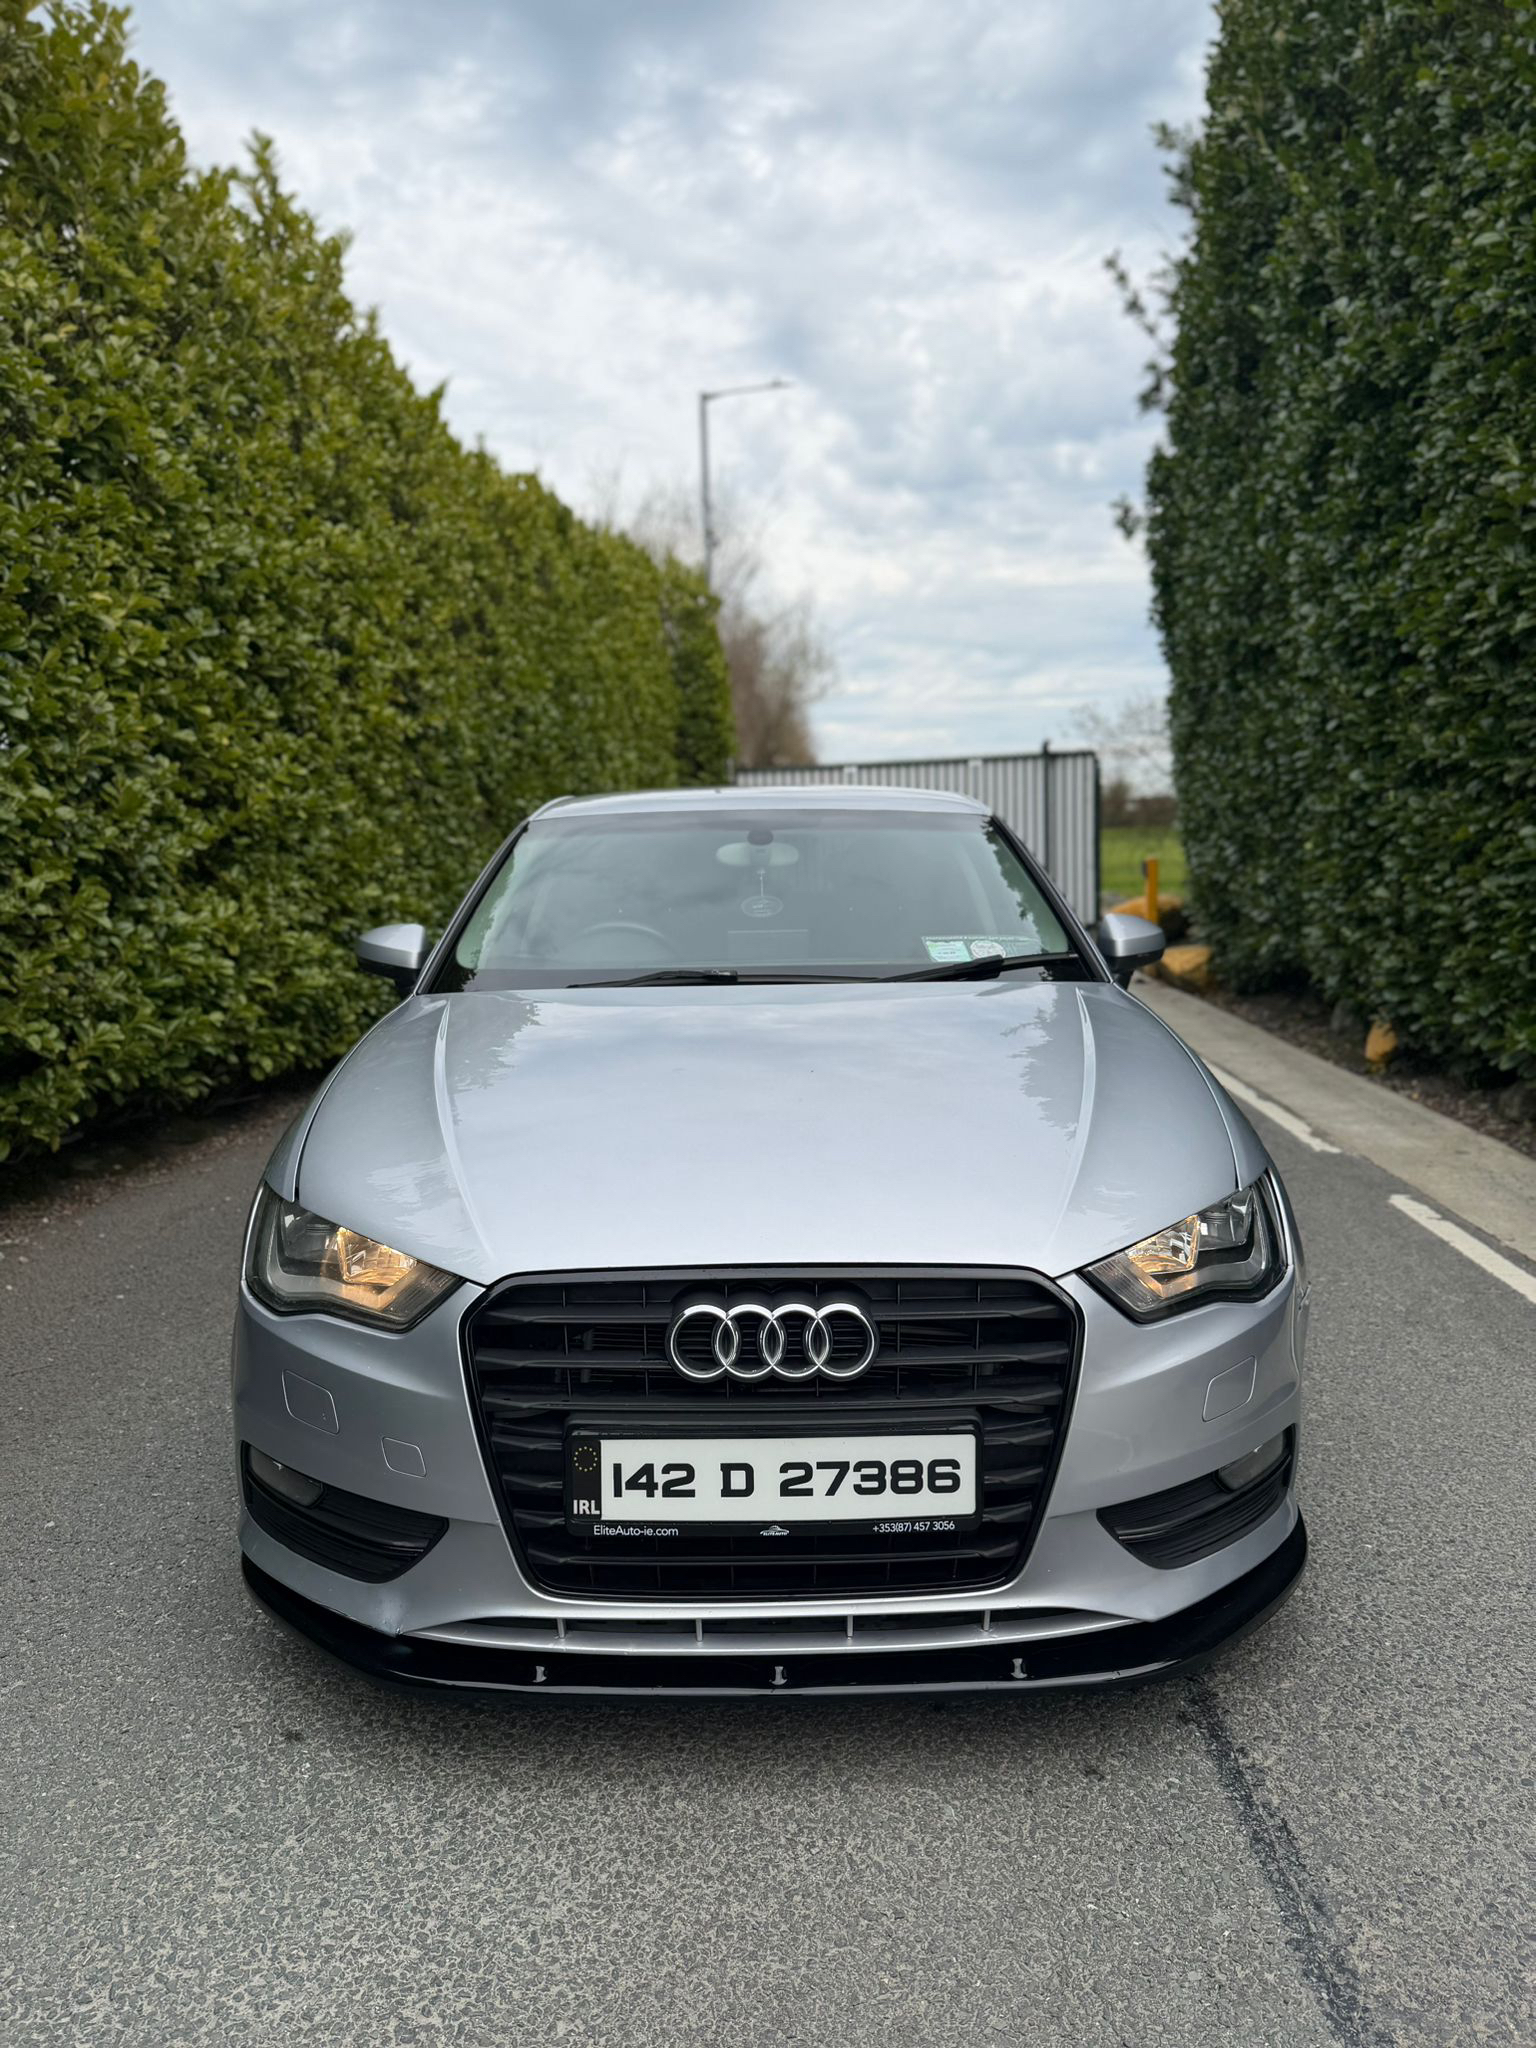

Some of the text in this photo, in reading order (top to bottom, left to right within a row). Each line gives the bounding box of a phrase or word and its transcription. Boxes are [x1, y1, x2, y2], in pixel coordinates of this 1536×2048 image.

[613, 1459, 961, 1498] 142 D 27386
[573, 1500, 600, 1515] IRL
[593, 1525, 679, 1536] EliteAuto-ie.com
[873, 1520, 955, 1533] +353(87) 457 3056
